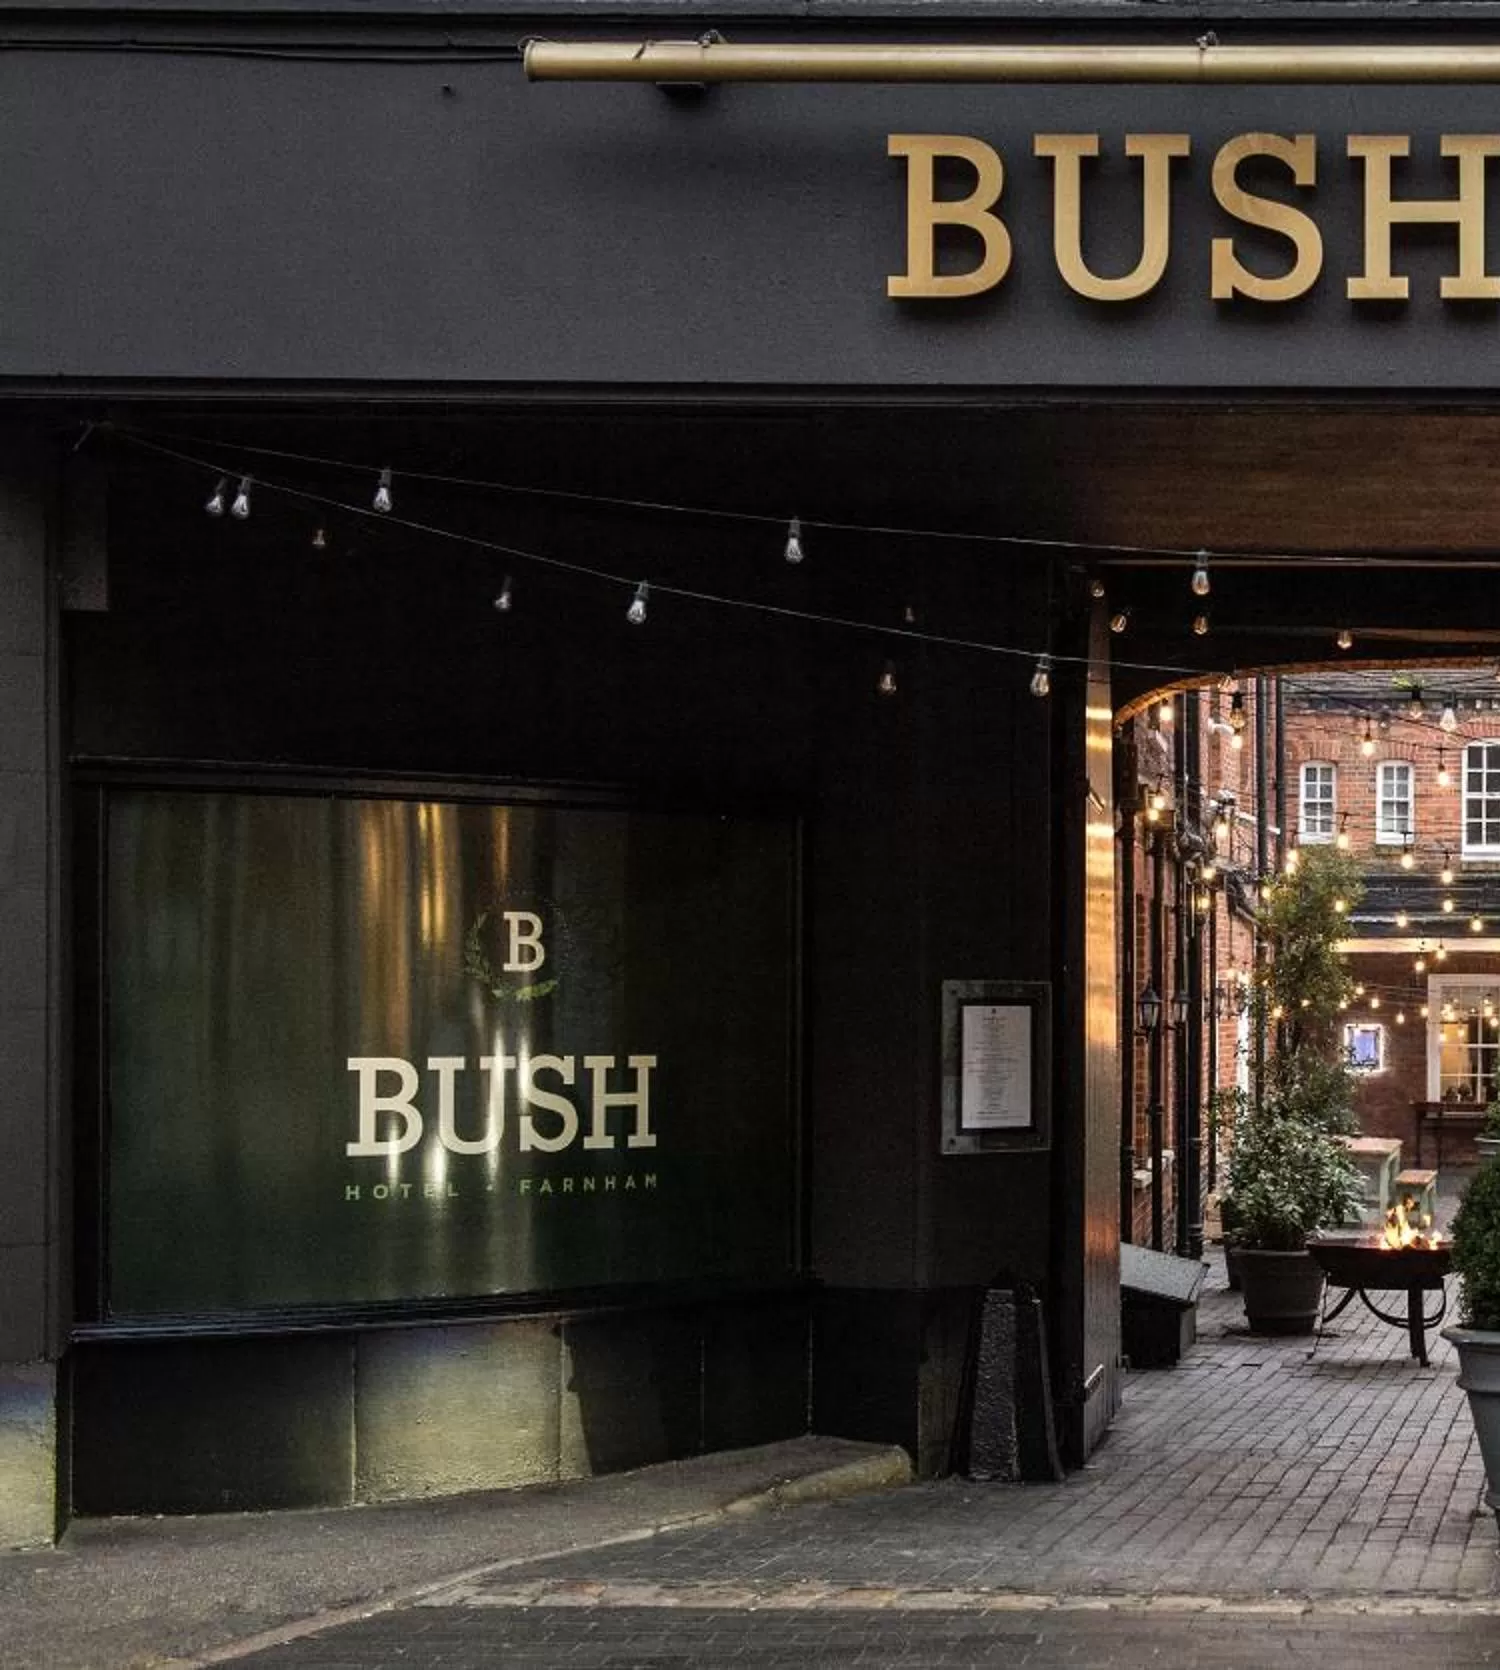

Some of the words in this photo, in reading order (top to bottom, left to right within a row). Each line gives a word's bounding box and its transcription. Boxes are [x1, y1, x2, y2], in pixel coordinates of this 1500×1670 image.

[502, 911, 546, 972] B
[346, 1054, 658, 1157] BUSH
[344, 1183, 461, 1201] HOTEL
[519, 1173, 657, 1196] FARNHAM
